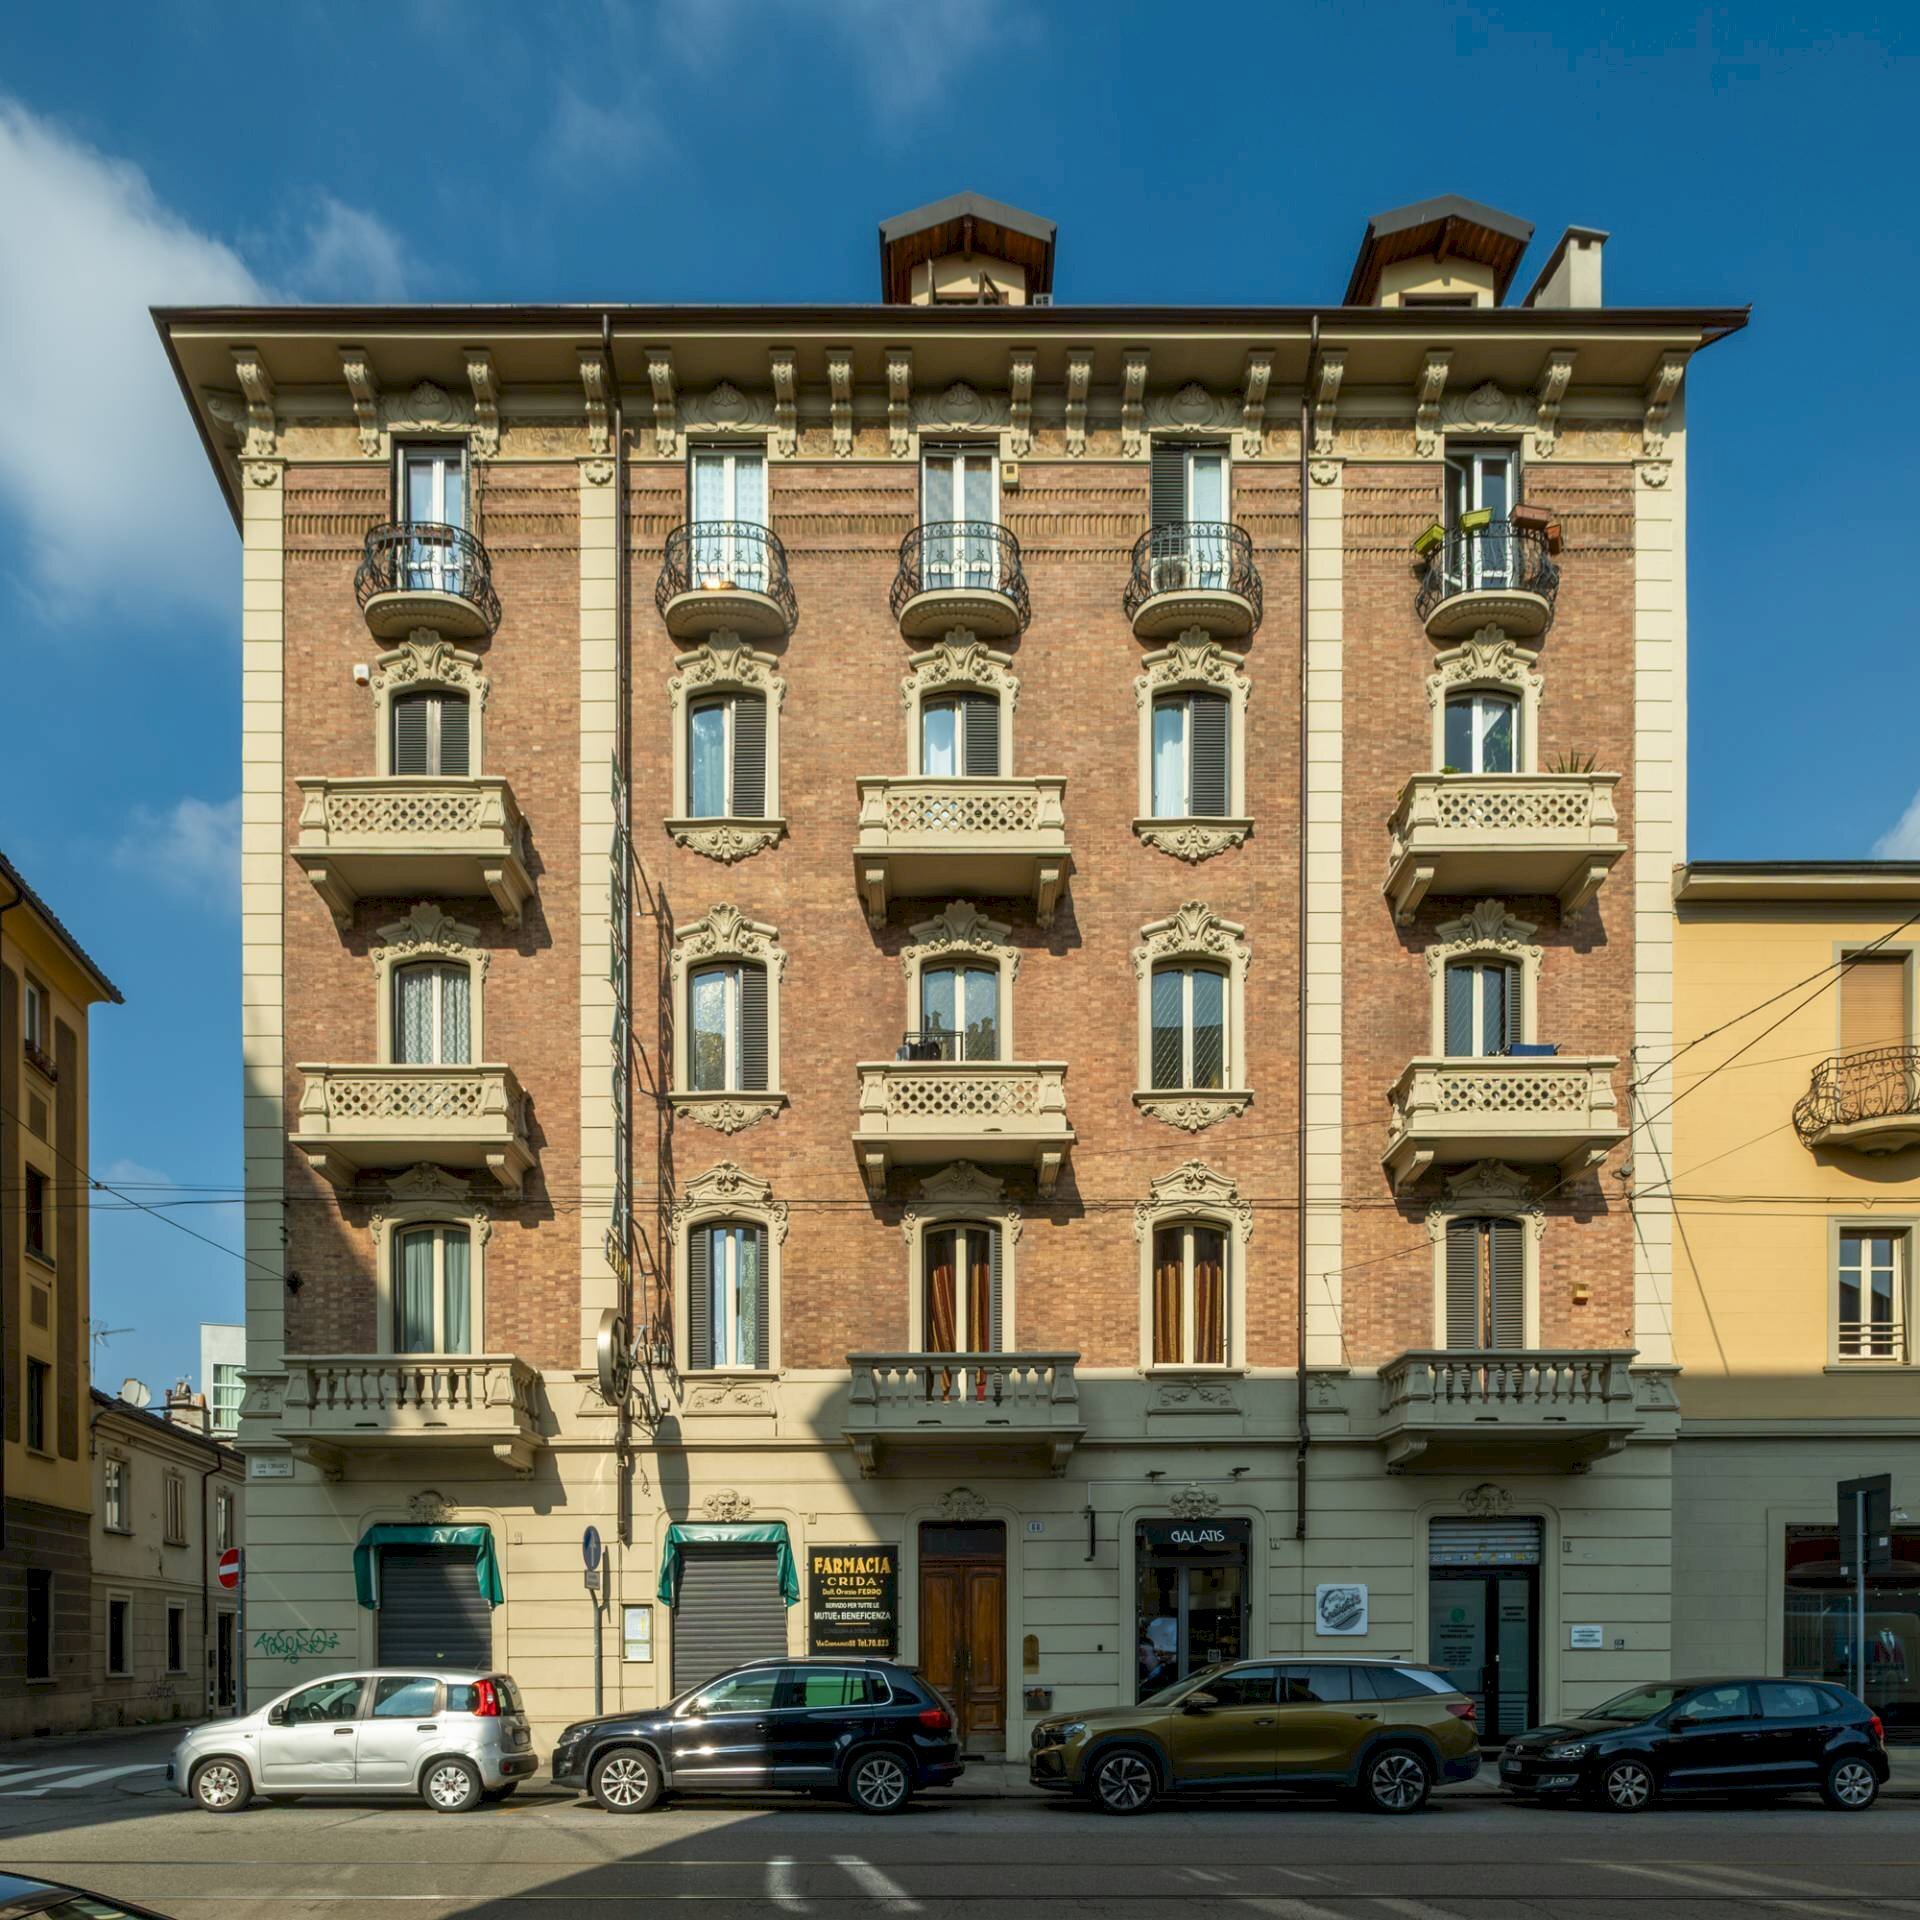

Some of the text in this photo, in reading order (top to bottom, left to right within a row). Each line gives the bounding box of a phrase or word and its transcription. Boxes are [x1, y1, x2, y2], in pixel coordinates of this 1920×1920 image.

[1171, 1529, 1225, 1543] GALATIS
[814, 1557, 891, 1574] FARMACIA
[827, 1577, 877, 1586] CRIDA
[814, 1611, 837, 1620] MUTUE
[841, 1611, 891, 1620] BENEFICENZA
